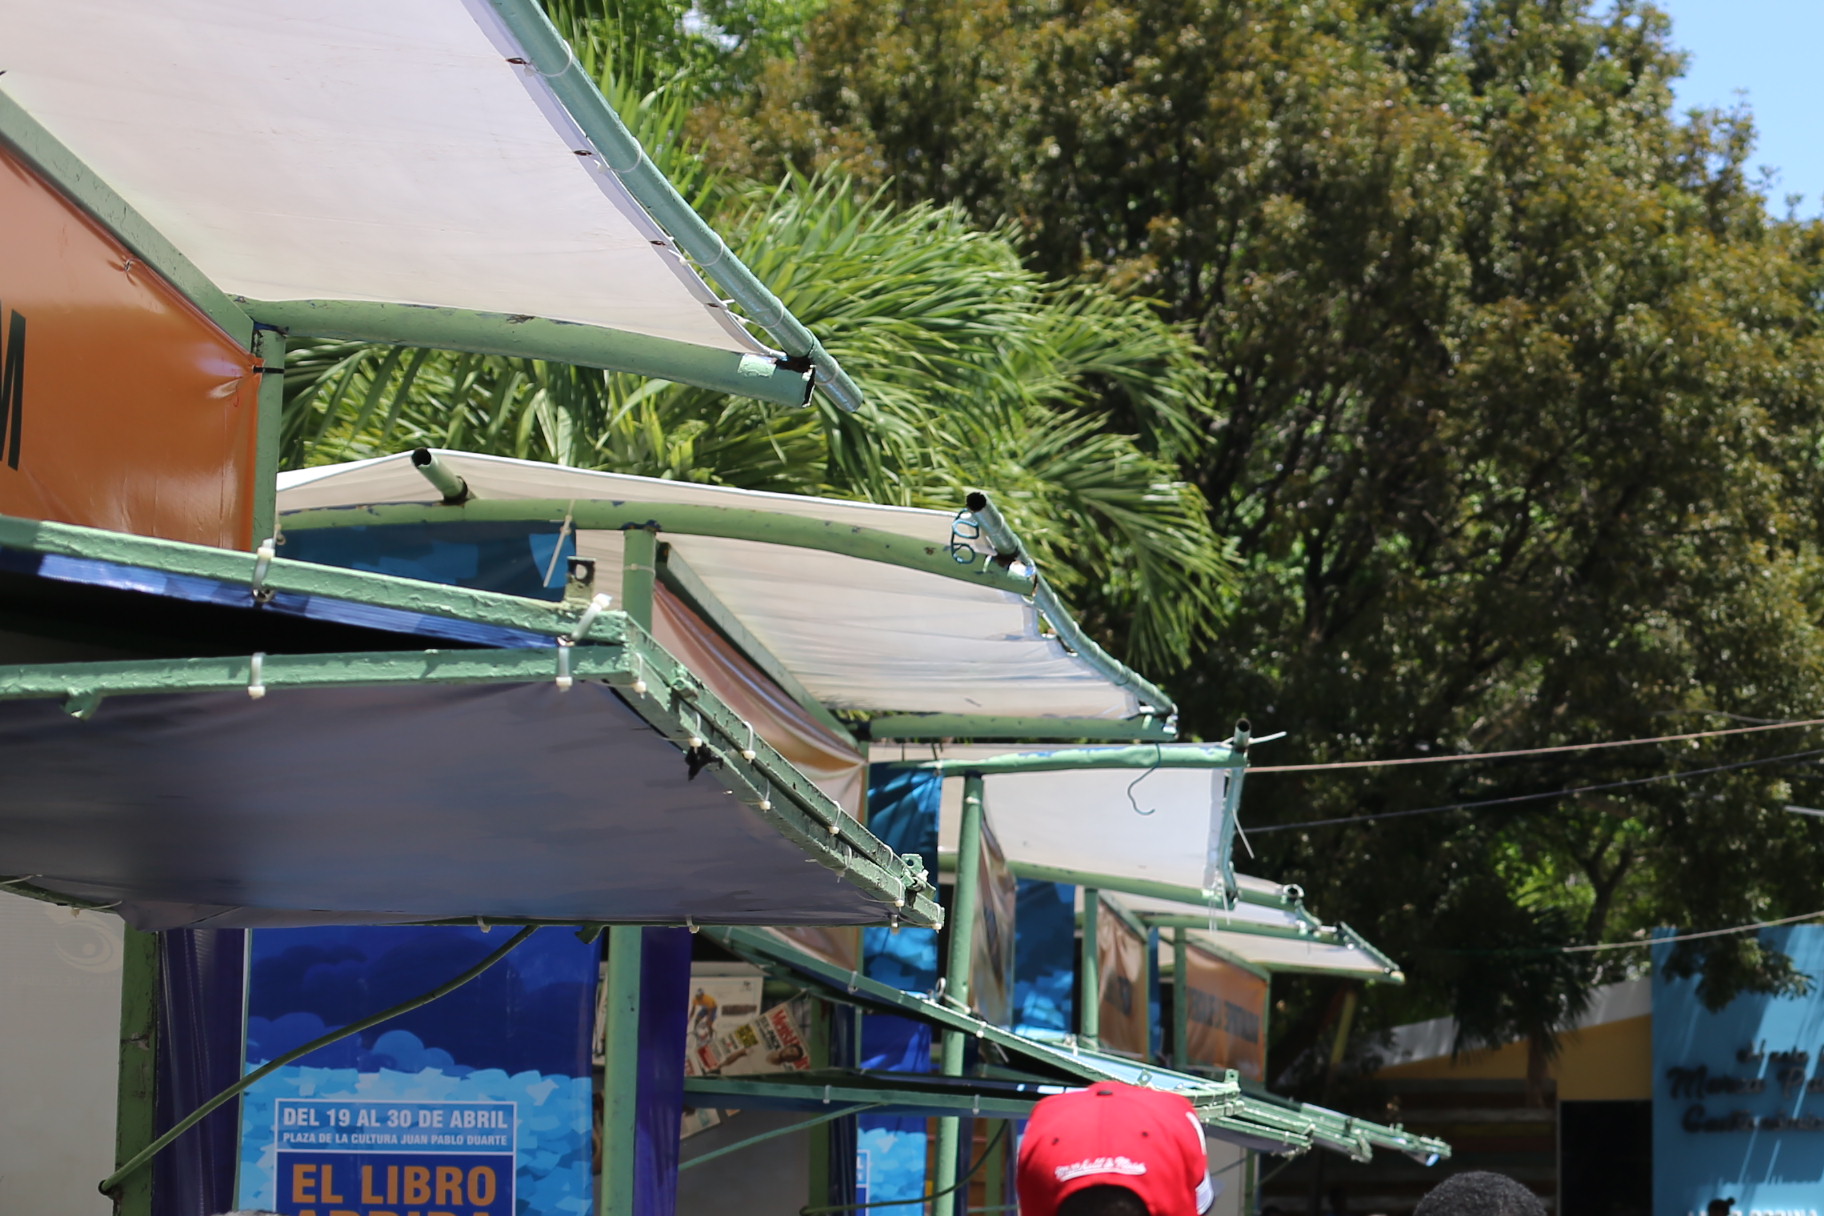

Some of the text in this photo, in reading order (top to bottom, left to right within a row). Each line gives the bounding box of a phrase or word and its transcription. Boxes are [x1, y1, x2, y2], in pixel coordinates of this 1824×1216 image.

[283, 1107, 508, 1129] DEL 19 AL 30 DE ABRIL
[283, 1132, 507, 1146] PLAZA DE LA CULTURA JUAN PABLO DUARTE
[292, 1163, 497, 1207] EL LIBRO
